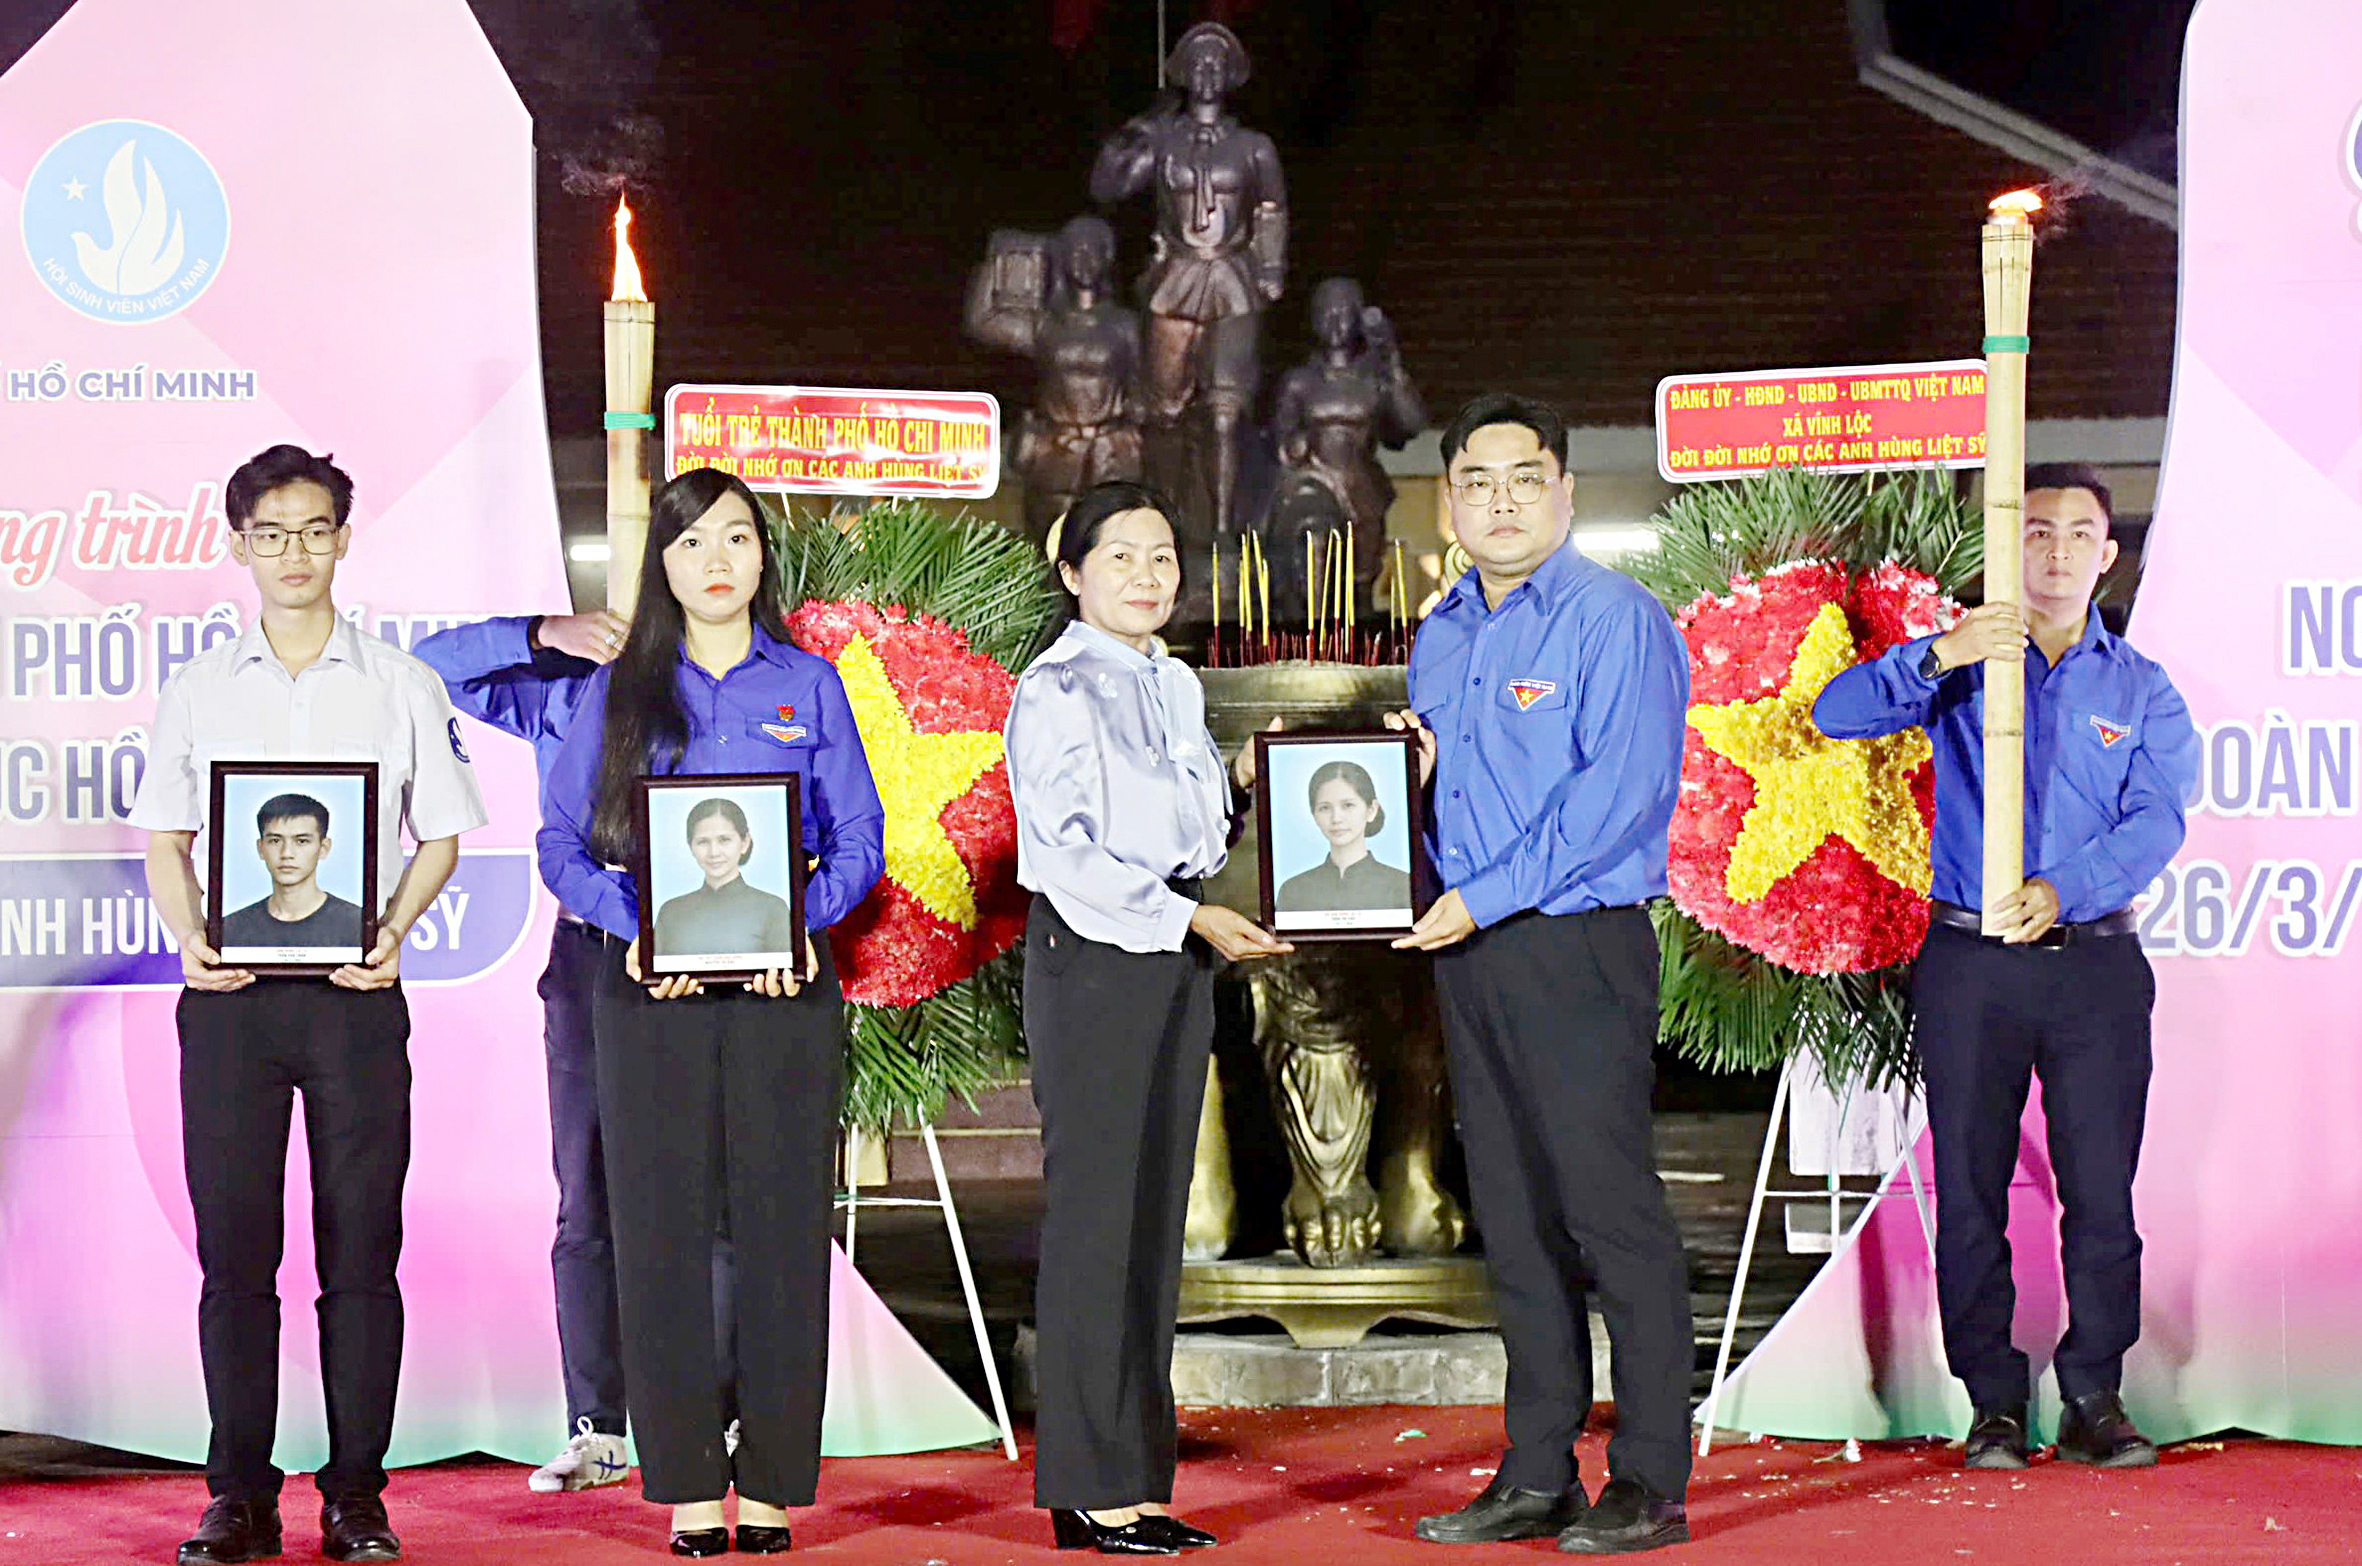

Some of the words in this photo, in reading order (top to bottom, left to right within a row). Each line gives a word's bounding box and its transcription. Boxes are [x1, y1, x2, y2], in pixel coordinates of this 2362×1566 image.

[43, 257, 68, 286] HỘI
[65, 281, 103, 310] SINH
[106, 298, 144, 314] VIÊN
[147, 286, 181, 311] VIỆT
[179, 257, 210, 291] NAM
[11, 363, 66, 397] HỒ
[79, 365, 146, 397] CHÍ
[156, 372, 254, 397] MINH
[1744, 385, 1785, 407] HĐND
[1797, 382, 1838, 404] UBND
[1850, 378, 1911, 402] UBMTTQ
[1913, 372, 1948, 402] VIỆT
[1951, 374, 1985, 396] NAM
[679, 396, 722, 447] TUỔI
[726, 404, 761, 447] TRẺ
[766, 405, 828, 450] THÀNH
[939, 421, 986, 453] MINH
[1670, 445, 1699, 468] ĐỜI
[1703, 444, 1732, 465] ĐỜI
[1737, 441, 1772, 464] NHỚ
[1776, 444, 1799, 462] ƠN
[1803, 439, 1834, 462] CÁC
[1839, 441, 1873, 460] ANH
[1878, 435, 1923, 458] HÙNG
[1927, 433, 1962, 459] LIỆT
[1845, 409, 1872, 439] LỘC
[743, 453, 777, 477] NHỚ
[808, 454, 838, 478] CÁC
[844, 460, 877, 479] ANH
[78, 488, 221, 564] trình
[13, 608, 134, 696] PHỐ
[66, 732, 146, 819] HỒ
[2186, 714, 2351, 810] OÀN
[83, 889, 179, 955] HÙN
